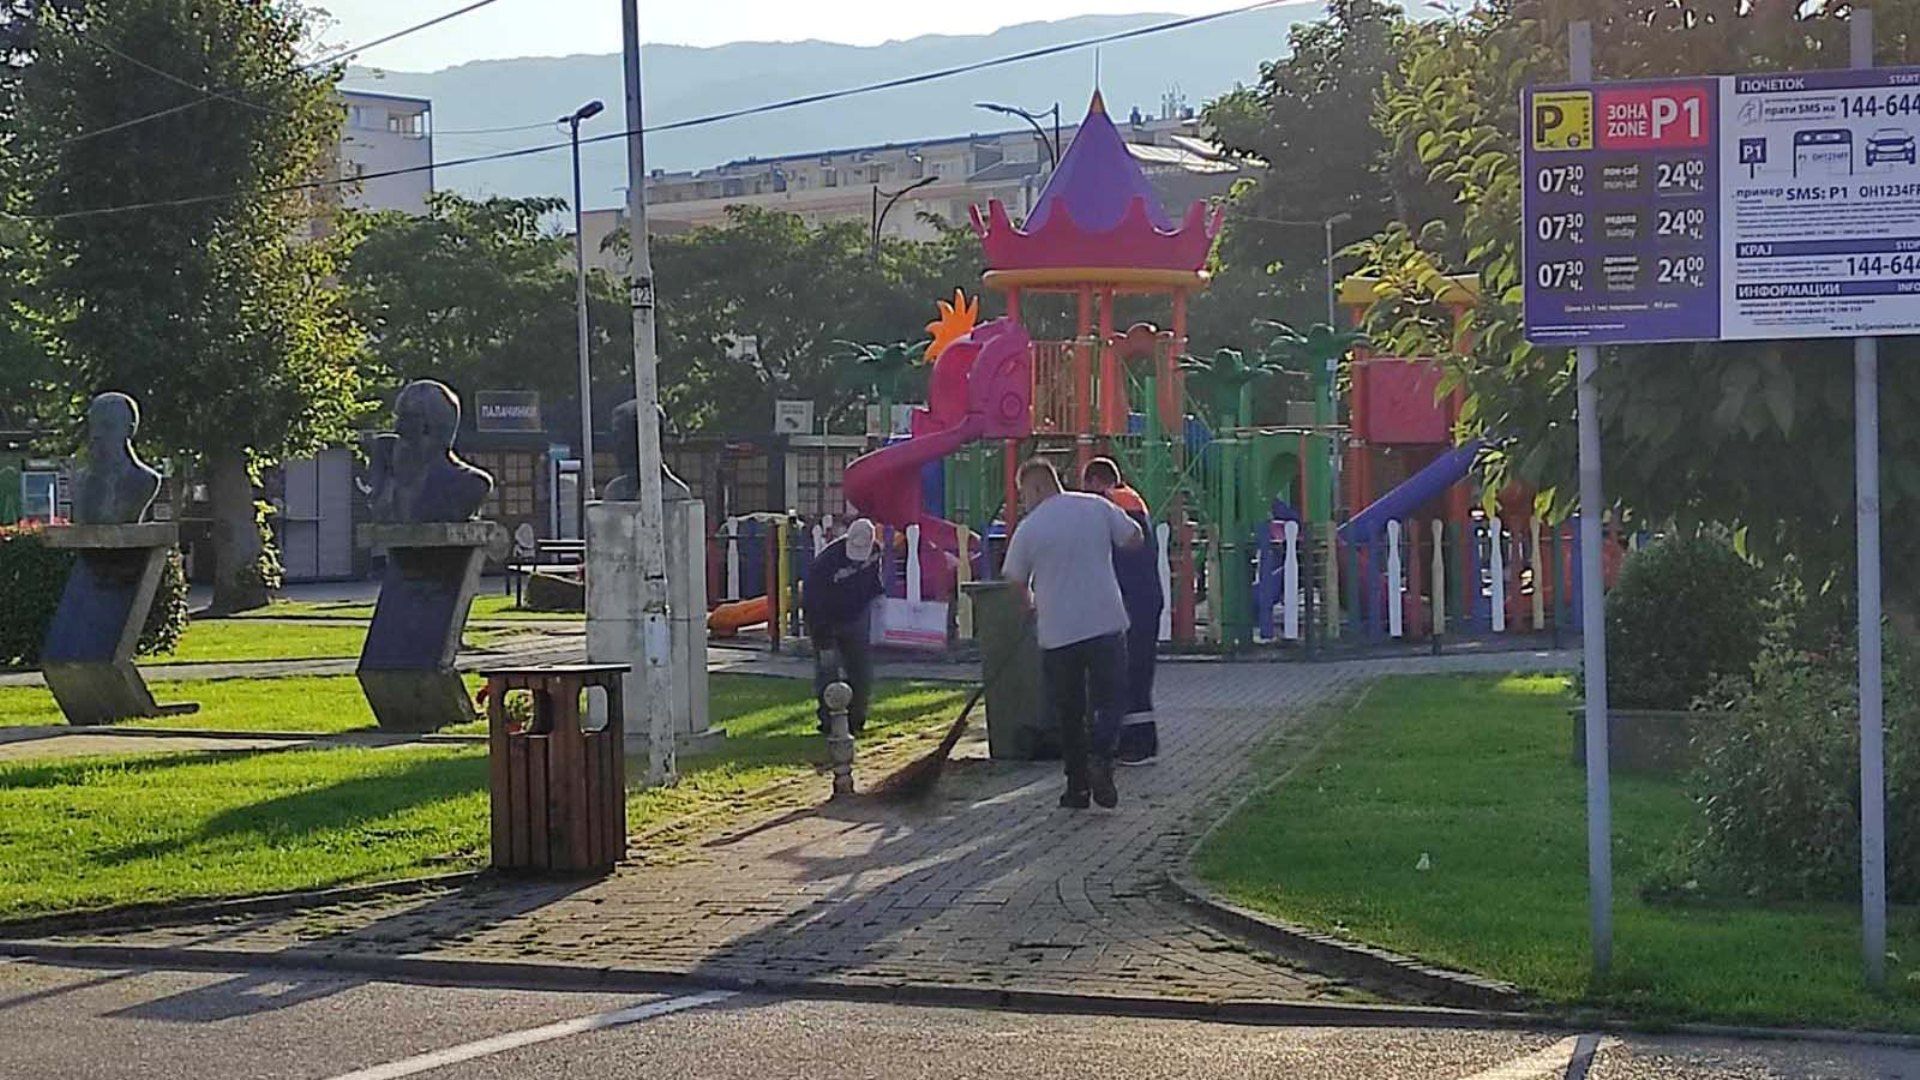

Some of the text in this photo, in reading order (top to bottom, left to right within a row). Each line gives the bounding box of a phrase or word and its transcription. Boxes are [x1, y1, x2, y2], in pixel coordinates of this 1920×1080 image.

[1741, 77, 1805, 92] ПОЧЕТОК
[1607, 103, 1648, 121] ЗОНА
[1798, 102, 1821, 114] SMS
[1841, 93, 1920, 118] 144-644
[1536, 105, 1563, 142] P
[1651, 97, 1700, 139] P1
[1607, 121, 1648, 137] ZONE
[1742, 144, 1762, 160] P1
[1737, 187, 1784, 199] пример
[1786, 187, 1826, 200] SMS:
[1829, 186, 1848, 199] P1
[1740, 243, 1773, 256] КРАЈ
[1738, 283, 1841, 298] ИНФОРМАЦИИ
